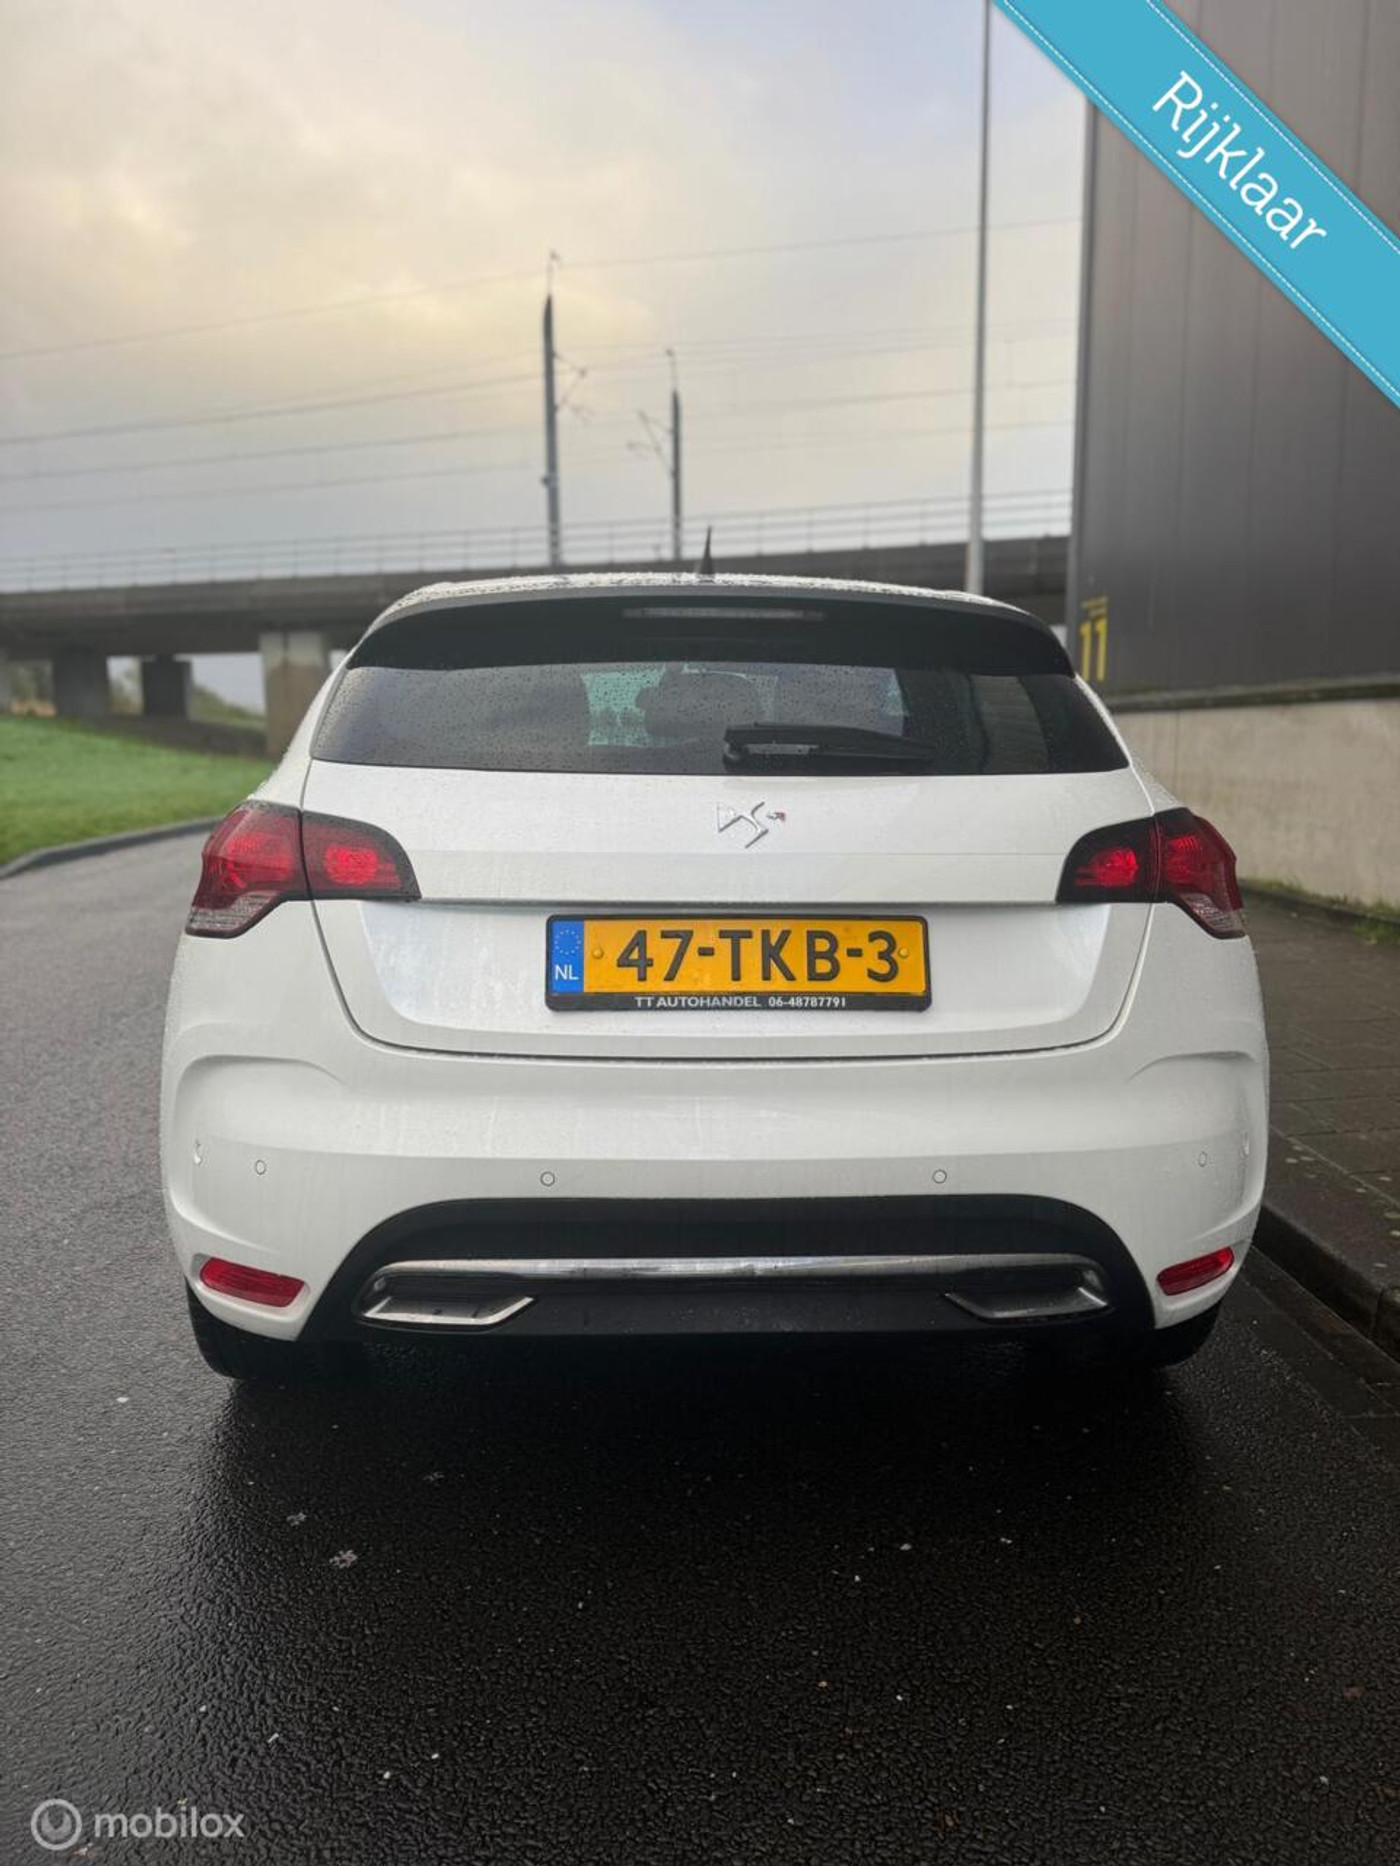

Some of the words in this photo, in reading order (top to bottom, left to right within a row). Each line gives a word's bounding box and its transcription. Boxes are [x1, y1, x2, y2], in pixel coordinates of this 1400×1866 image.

[1079, 619, 1108, 681] 11
[554, 964, 579, 980] NL
[616, 929, 899, 983] 47-TKB-3
[635, 996, 654, 1008] TT
[656, 996, 762, 1008] AUTOHANDEL
[768, 997, 847, 1008] 06-48787791
